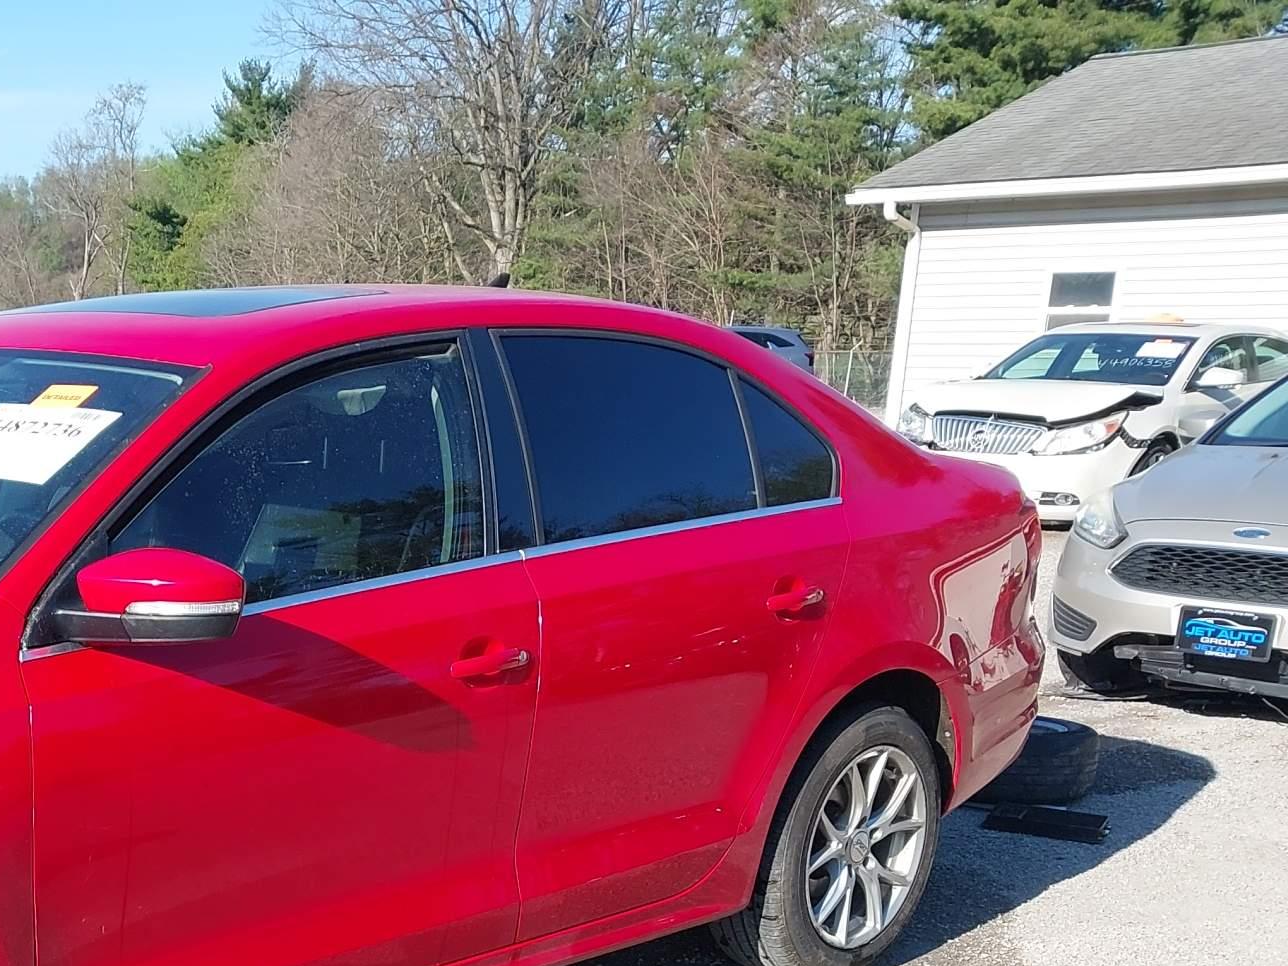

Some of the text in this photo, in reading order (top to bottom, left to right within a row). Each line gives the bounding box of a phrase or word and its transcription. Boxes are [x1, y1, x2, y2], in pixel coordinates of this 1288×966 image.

[1186, 627, 1265, 643] JET AUTO
[1200, 637, 1247, 647] GROUP
[1204, 650, 1237, 658] GROUP
[1220, 646, 1249, 656] AUTO
